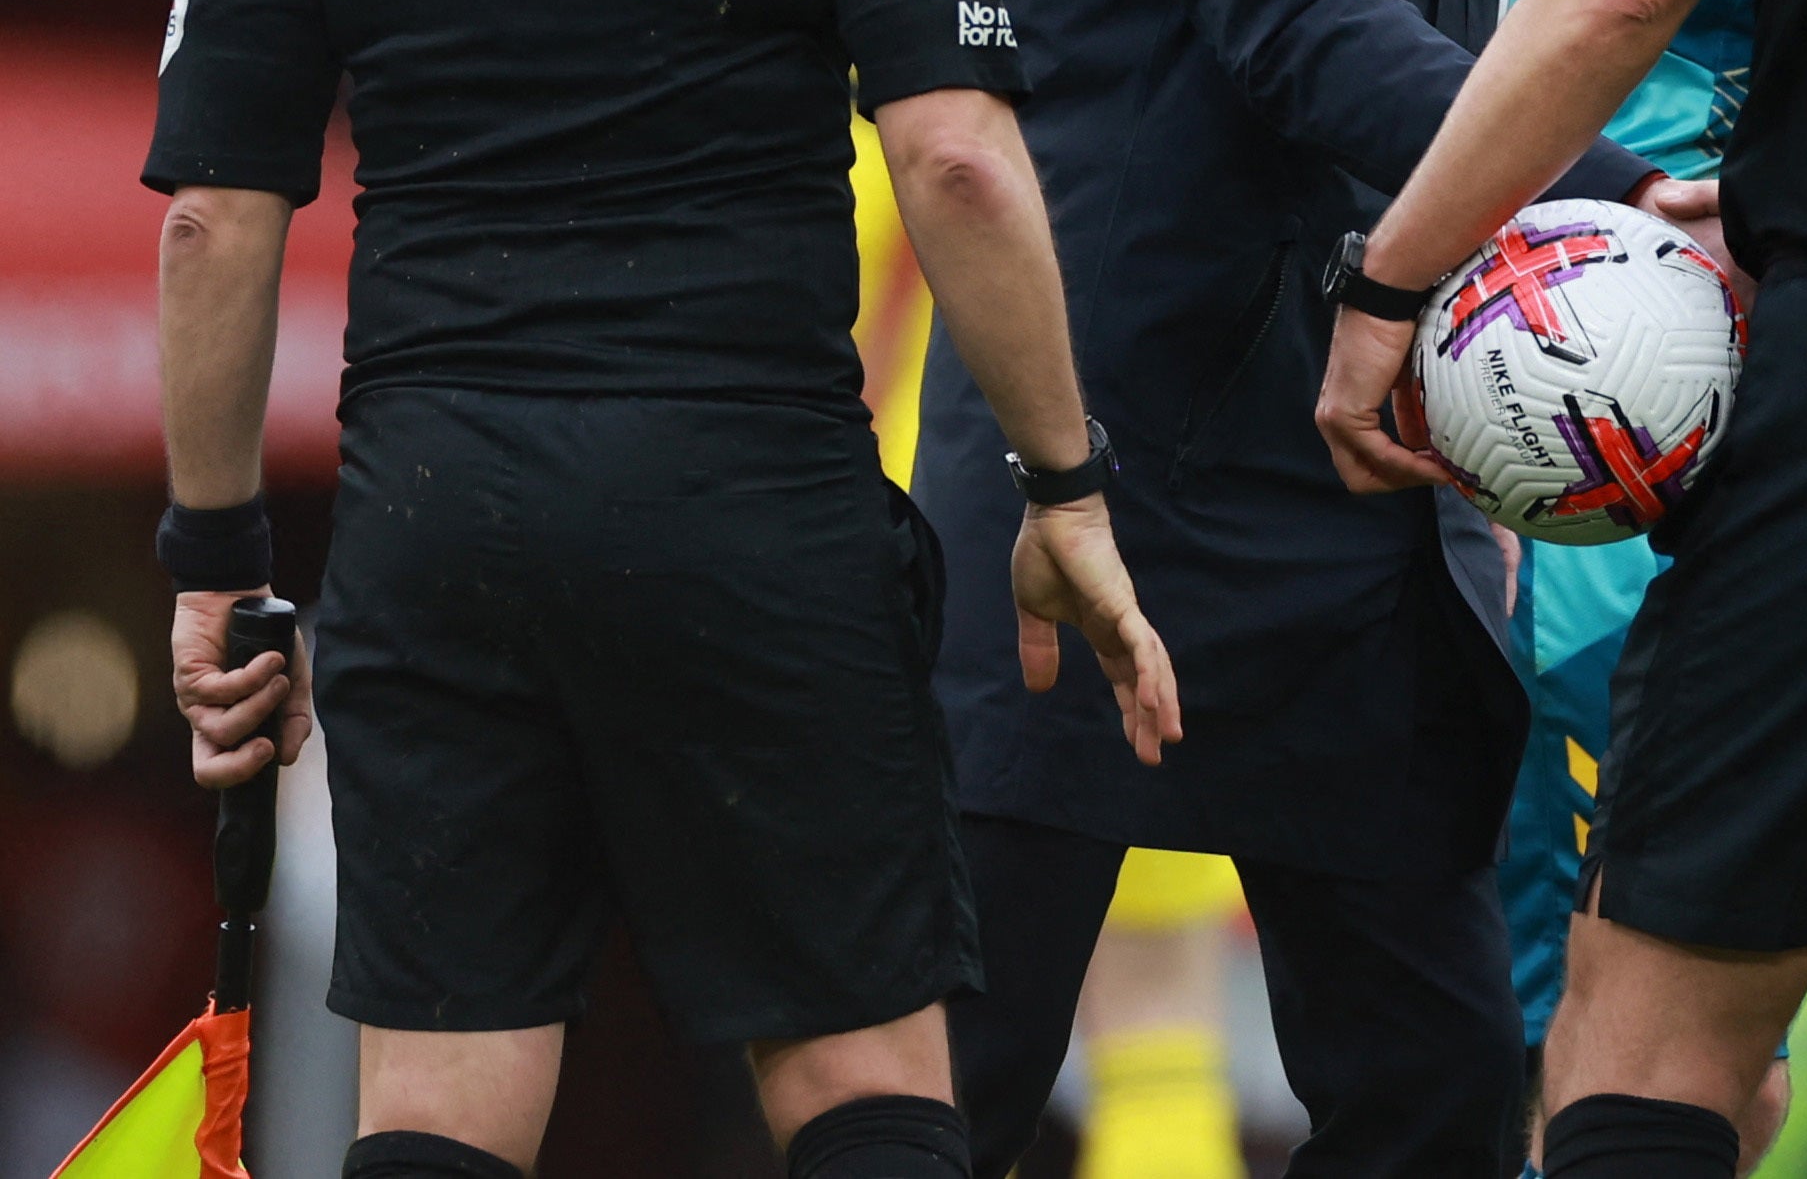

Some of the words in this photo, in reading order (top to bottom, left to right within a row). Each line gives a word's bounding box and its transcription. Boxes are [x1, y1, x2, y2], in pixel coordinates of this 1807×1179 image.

[958, 1, 996, 26] No
[958, 22, 994, 47] for
[1478, 358, 1506, 416] PREMIER
[1501, 418, 1537, 467] LEAGUE
[1487, 349, 1516, 398] NIKE
[1506, 402, 1557, 468] FLIGHT
